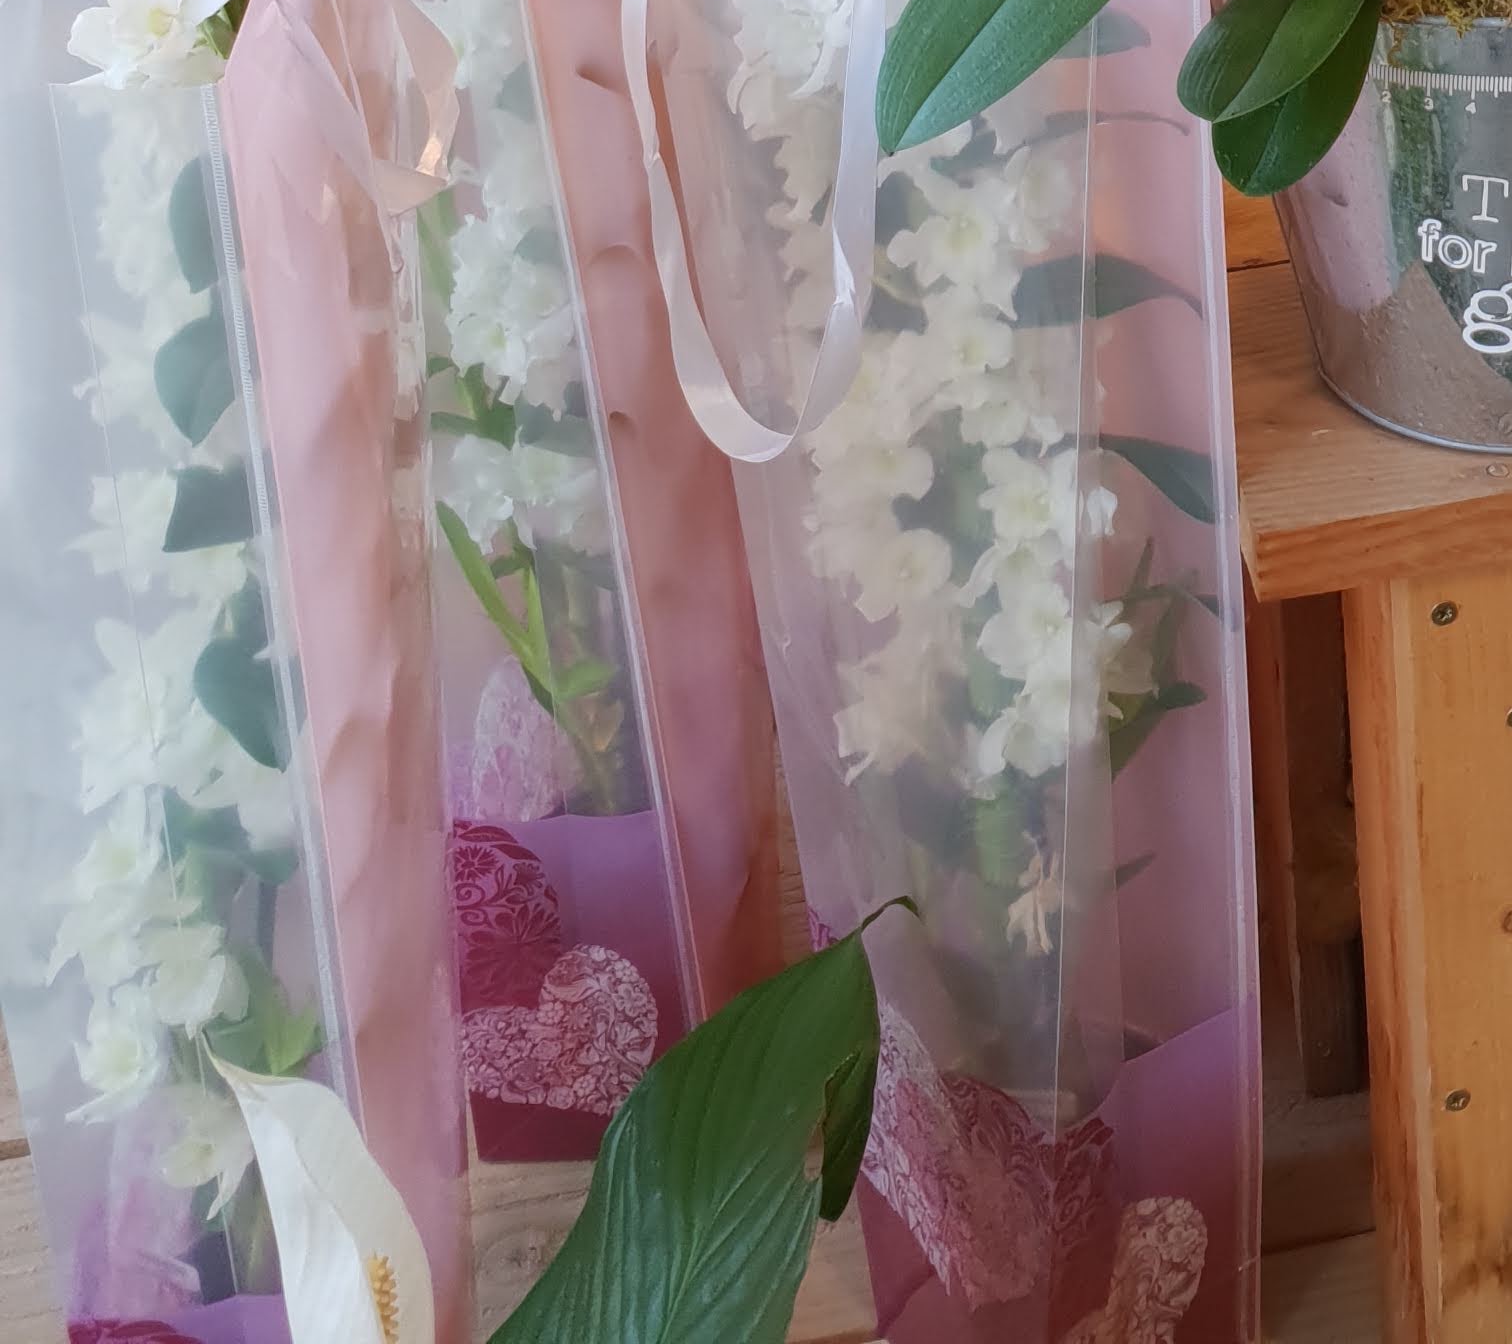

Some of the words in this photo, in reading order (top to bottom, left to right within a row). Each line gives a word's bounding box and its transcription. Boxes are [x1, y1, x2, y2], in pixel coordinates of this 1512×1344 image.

[1381, 90, 1392, 104] 2
[1424, 98, 1434, 111] 3
[1465, 102, 1477, 114] 4
[1417, 218, 1498, 274] for
